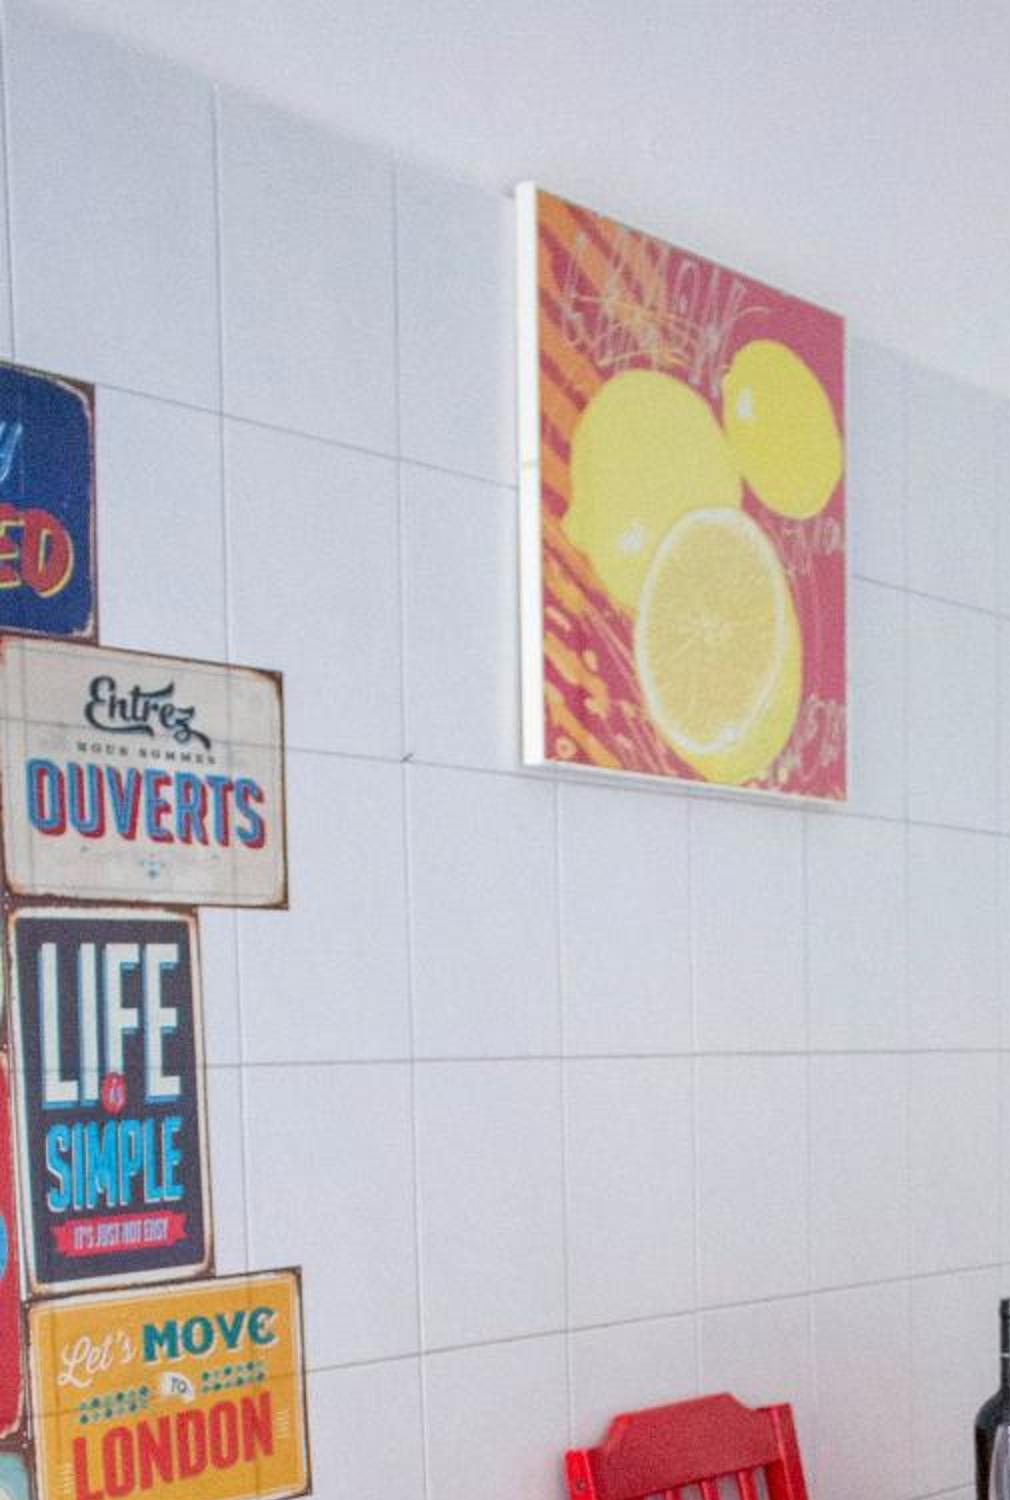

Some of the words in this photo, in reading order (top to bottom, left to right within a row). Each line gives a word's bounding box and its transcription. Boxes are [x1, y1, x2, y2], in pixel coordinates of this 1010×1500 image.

[84, 675, 212, 749] Entrez
[25, 757, 266, 849] OUVERTS
[40, 943, 181, 1109] LIFE
[46, 1116, 184, 1212] SIMPLE
[58, 1330, 135, 1388] Let's
[143, 1307, 277, 1364] MOVE
